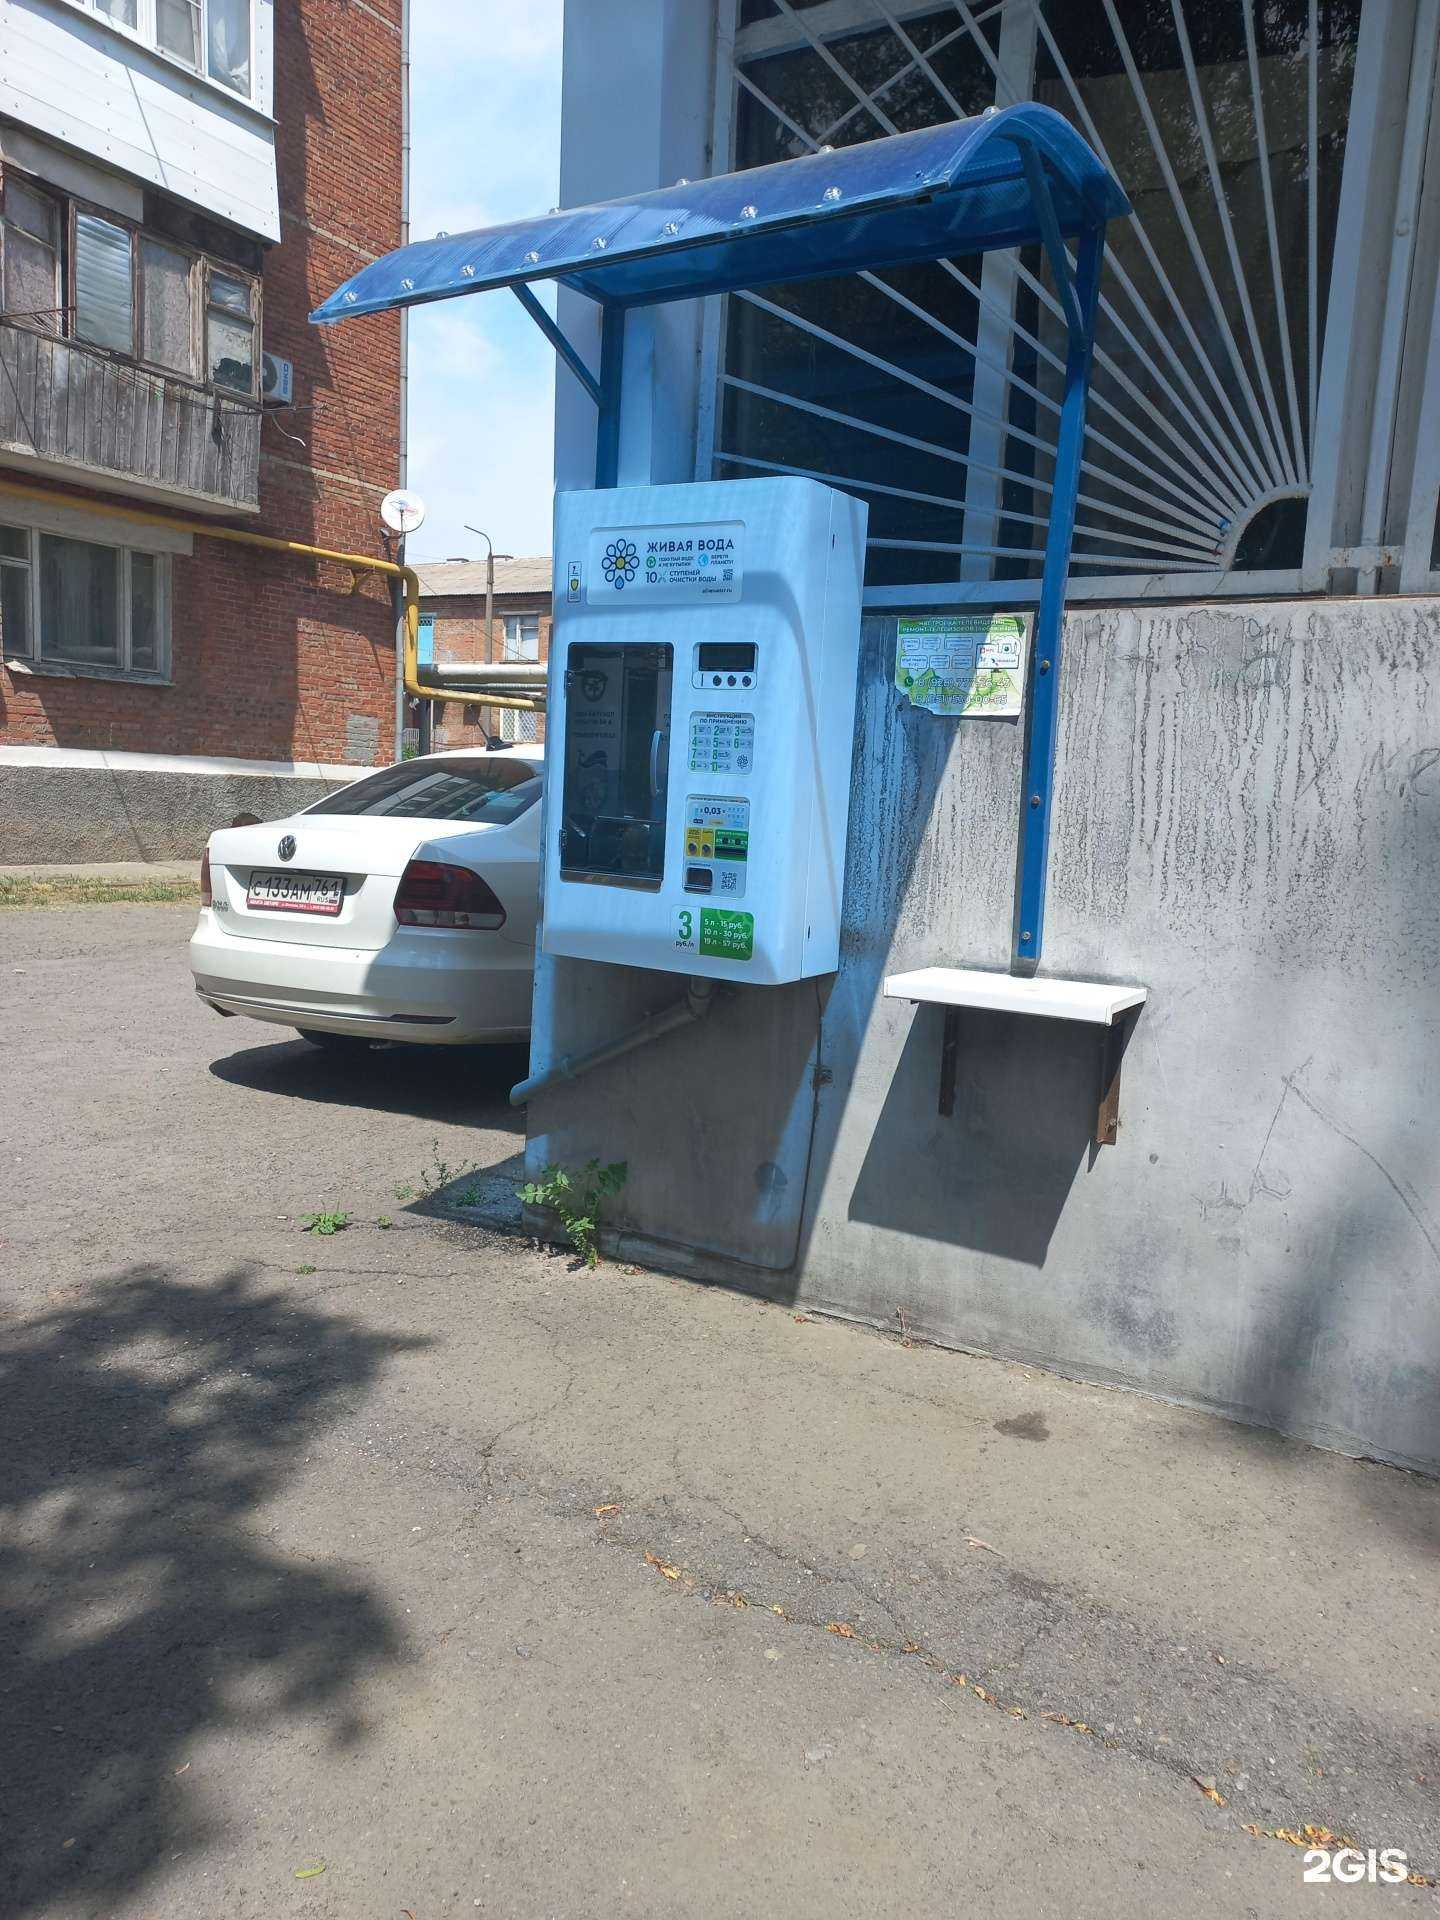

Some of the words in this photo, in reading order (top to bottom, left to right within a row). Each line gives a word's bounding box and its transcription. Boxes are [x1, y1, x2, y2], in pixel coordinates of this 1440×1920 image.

[646, 540, 693, 553] ЖИВАЯ
[697, 538, 735, 551] ВОДА
[645, 571, 658, 584] 10
[669, 569, 701, 577] СТУПЕНЕЙ
[714, 725, 720, 736] 2
[713, 737, 718, 748] 5
[733, 738, 739, 748] 6
[704, 807, 721, 815] 0,03
[679, 911, 692, 939] 3
[720, 920, 728, 928] 15
[728, 922, 744, 930] руб.
[704, 928, 712, 936] 10
[732, 942, 747, 950] руб.
